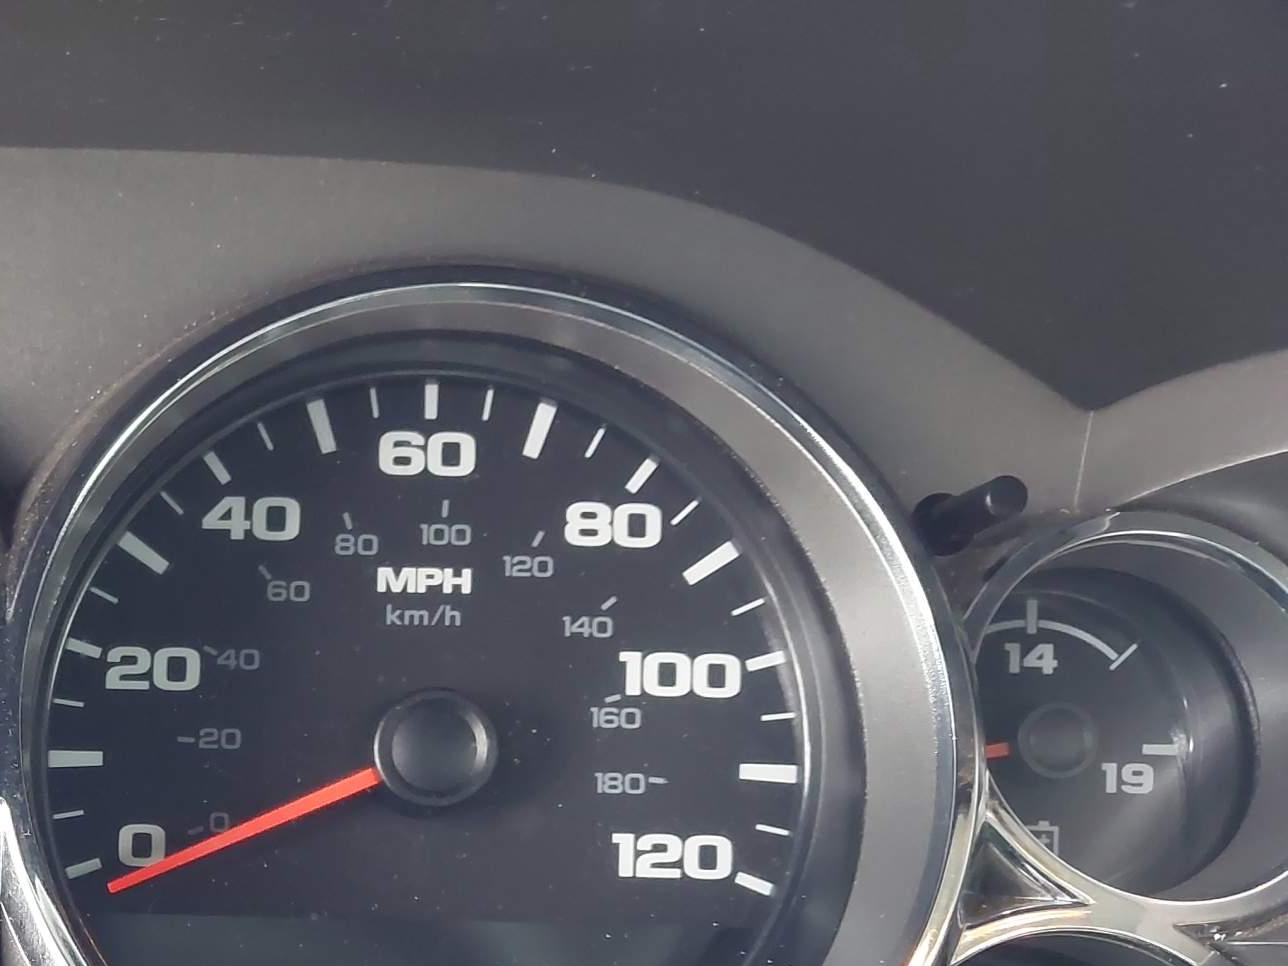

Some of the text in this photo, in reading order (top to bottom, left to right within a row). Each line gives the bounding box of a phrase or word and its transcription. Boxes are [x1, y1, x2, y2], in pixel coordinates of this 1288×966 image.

[377, 430, 477, 477] 60
[201, 495, 301, 541] 40
[563, 501, 663, 549] 80
[333, 533, 379, 557] 80
[420, 523, 472, 546] 100
[503, 555, 554, 578] 120
[265, 580, 311, 602] 60
[376, 566, 472, 594] MPH
[384, 604, 462, 628] km/h
[562, 615, 613, 639] 140
[104, 645, 201, 692] 20
[216, 648, 261, 671] 40
[1003, 642, 1059, 675] 14
[618, 650, 742, 699] 100
[590, 706, 642, 730] 160
[198, 728, 242, 750] 20
[594, 771, 647, 795] 180
[1101, 762, 1154, 794] 19
[118, 823, 167, 869] 0
[612, 832, 734, 880] 120
